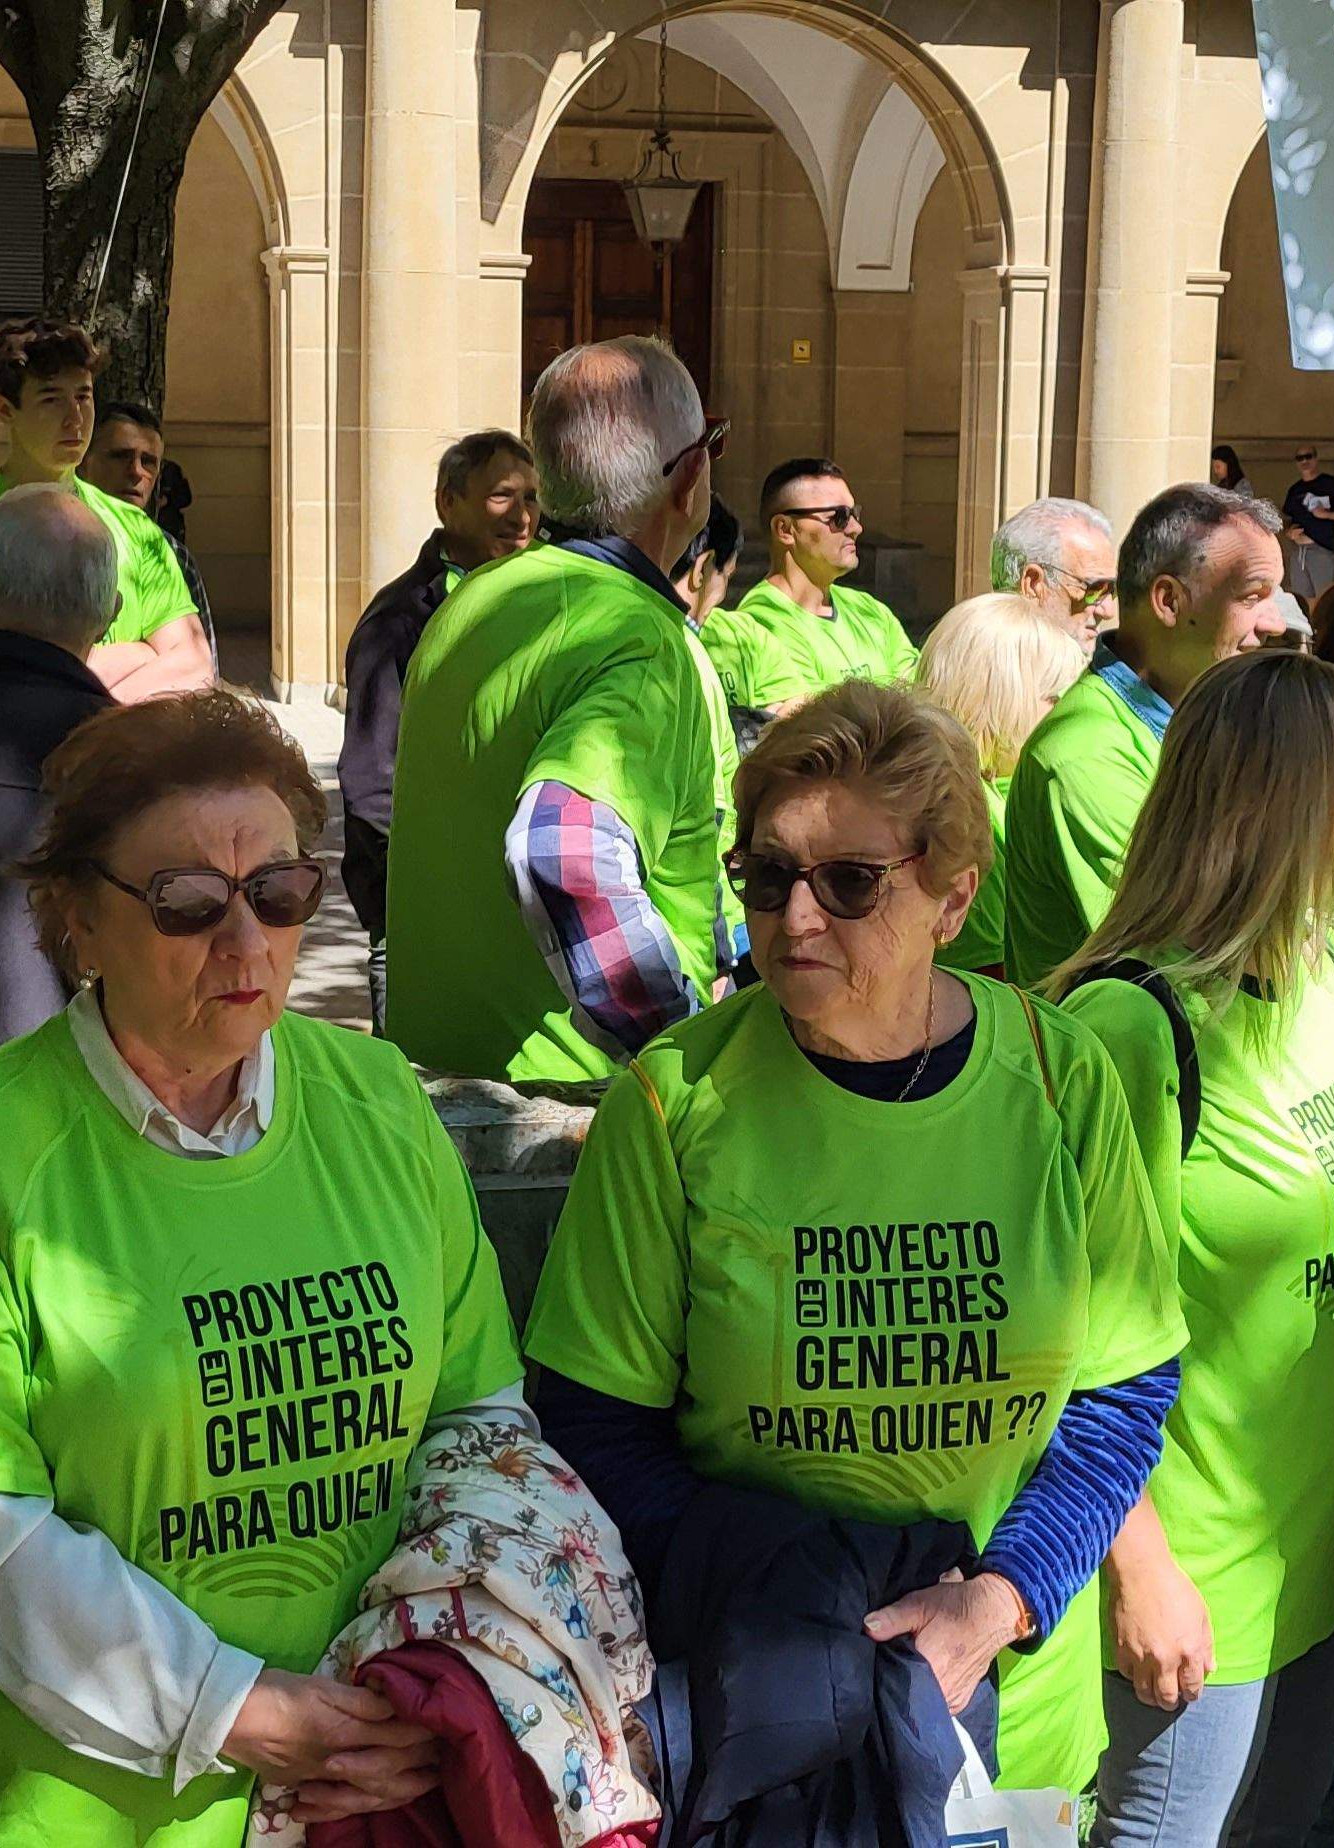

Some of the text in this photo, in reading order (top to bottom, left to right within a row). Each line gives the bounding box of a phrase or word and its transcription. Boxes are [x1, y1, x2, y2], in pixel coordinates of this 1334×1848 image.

[793, 1220, 1001, 1275] PROYECTO
[182, 1261, 400, 1348] PROYECTO
[796, 1273, 1010, 1329] DE INTERES
[198, 1316, 414, 1408] DE INTERES
[795, 1328, 1011, 1391] GENERAL
[205, 1379, 409, 1478] GENERAL
[748, 1391, 1048, 1456] PARA QUIEN ??
[159, 1458, 394, 1563] PARA QUIEN
